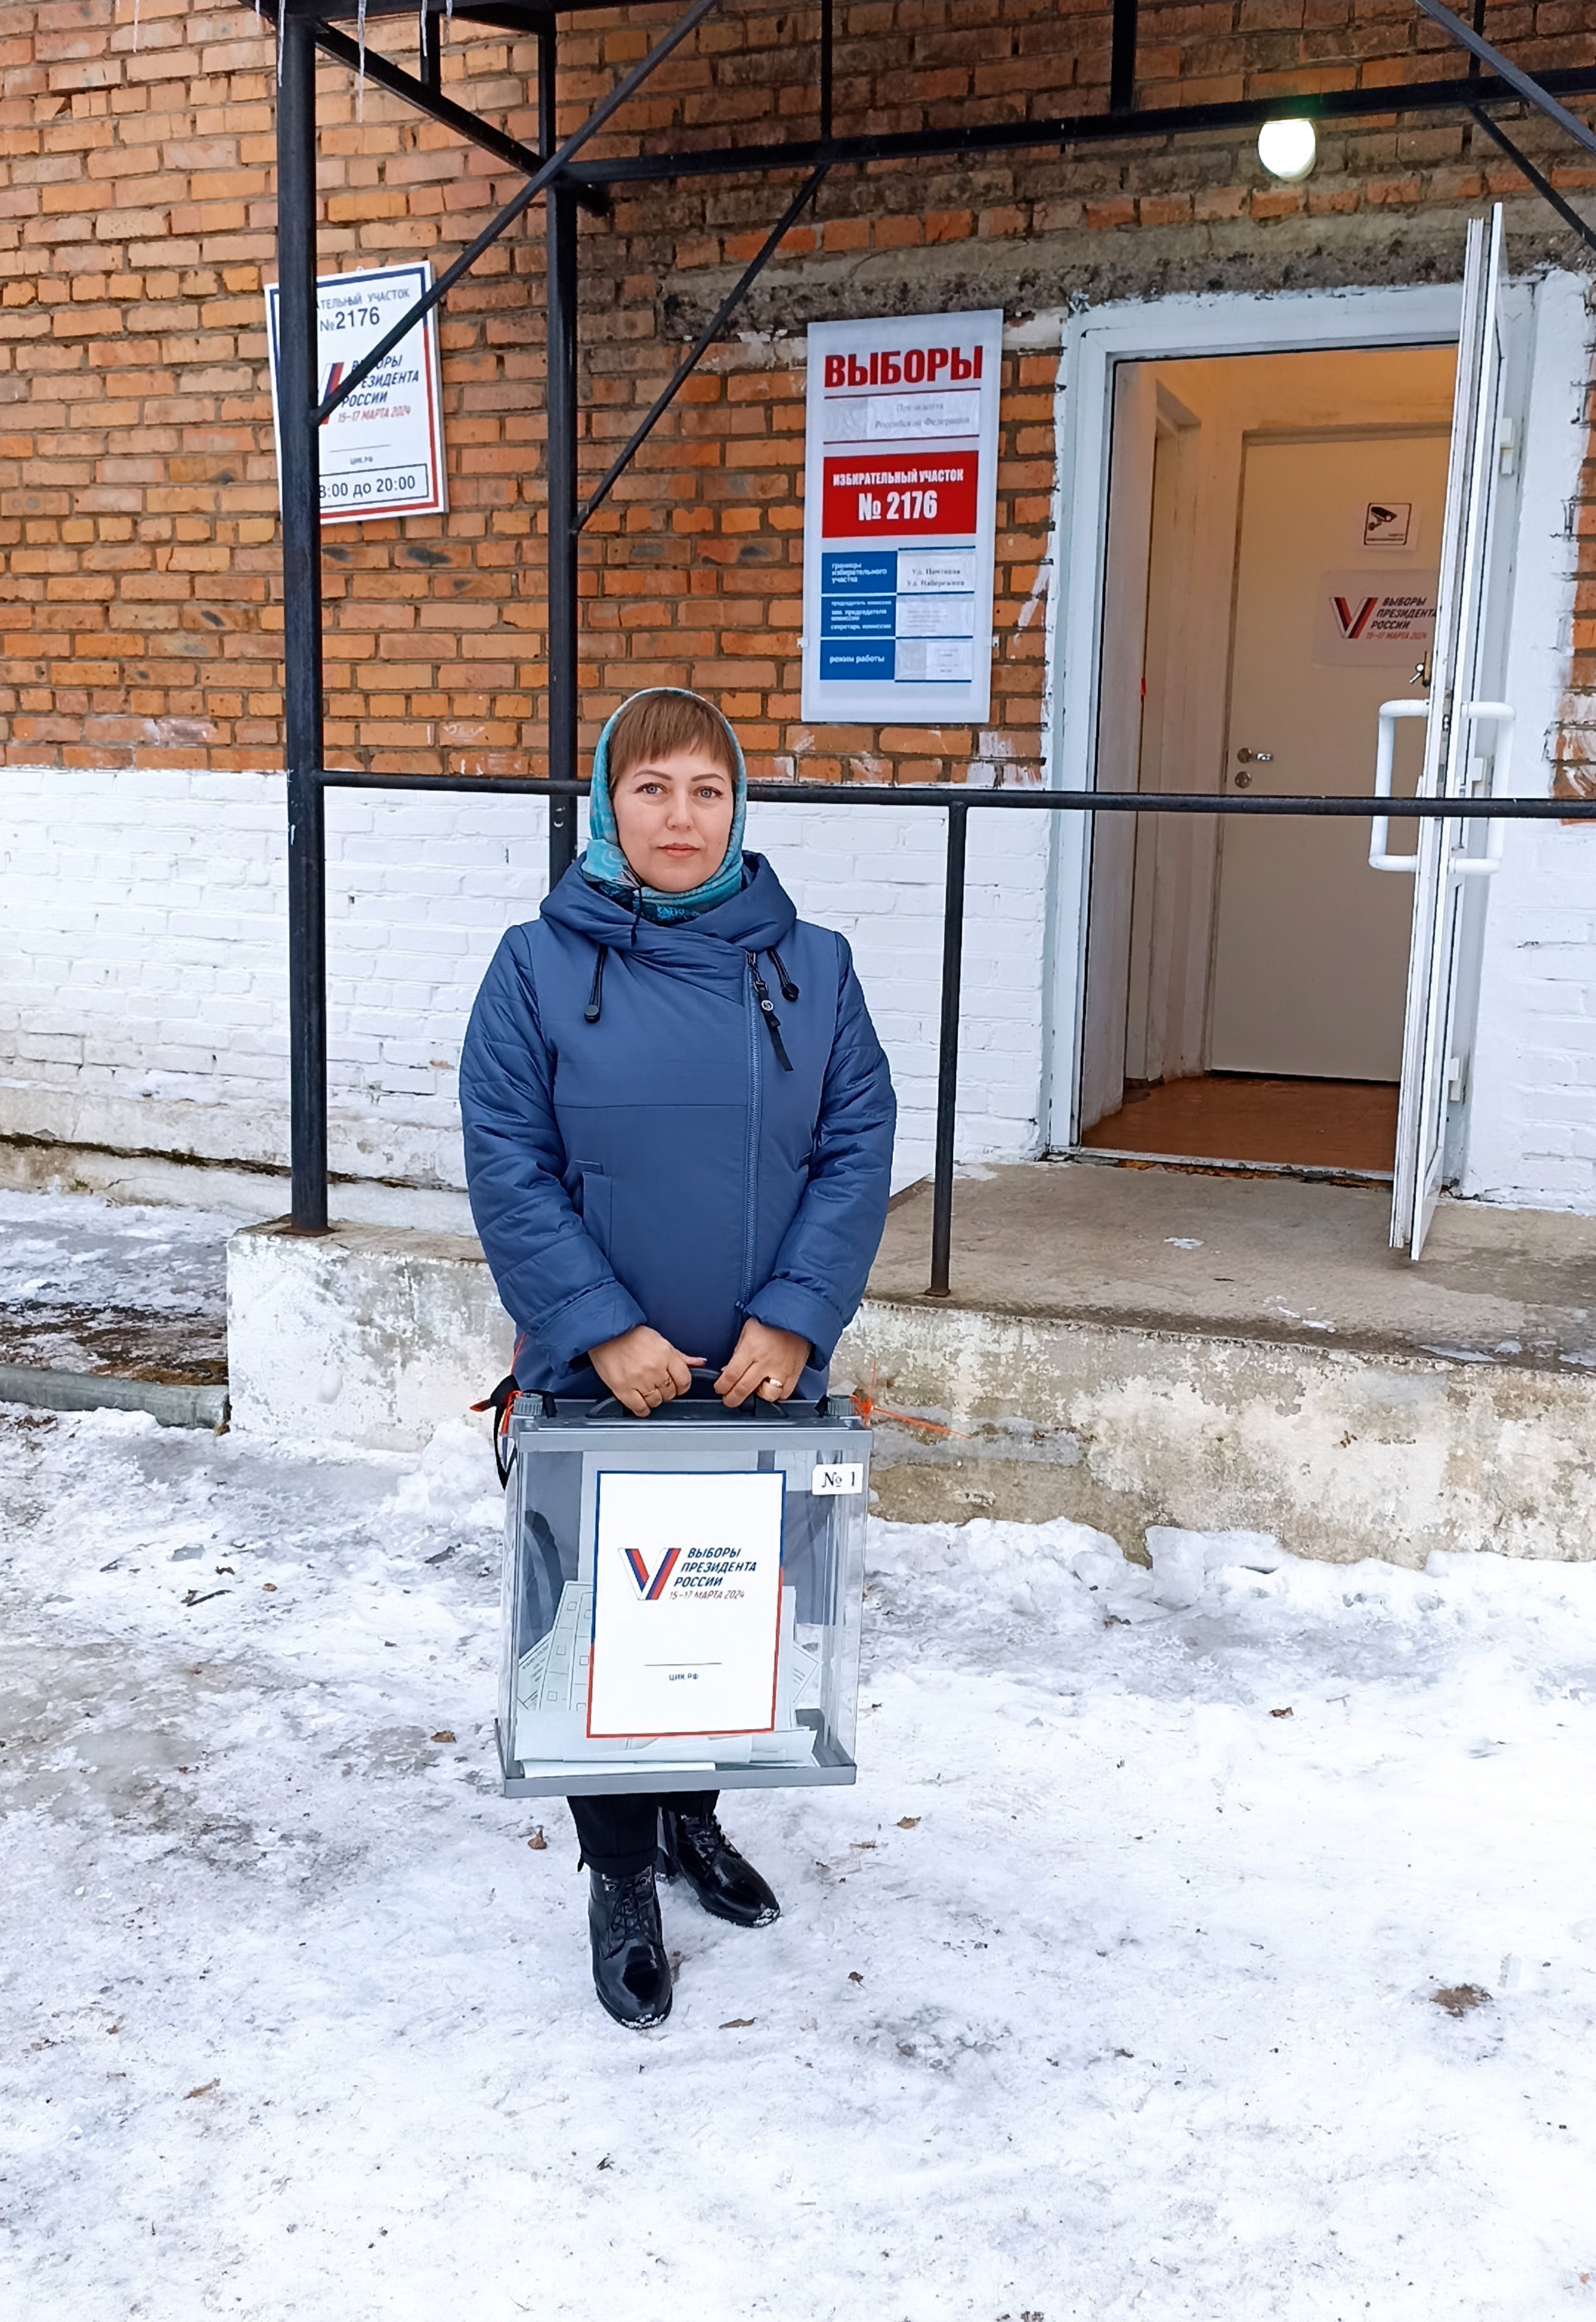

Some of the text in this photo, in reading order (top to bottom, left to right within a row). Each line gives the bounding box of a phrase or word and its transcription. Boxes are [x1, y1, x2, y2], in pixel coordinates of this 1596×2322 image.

[317, 288, 410, 310] ТЕЛЬНЫЙ УЧАСТОК
[352, 355, 403, 370] ВОРЫ
[824, 345, 983, 388] ВЫБОРЫ
[361, 370, 419, 388] ЕЗИДЕНТА
[341, 391, 388, 408] РОССИИ
[361, 407, 390, 420] МАРТА
[391, 405, 411, 417] 2024
[833, 468, 964, 487] ИЗБИРАТЕЛЬНЫЙ УЧАСТОК
[353, 483, 371, 498] до
[376, 475, 415, 493] 20:00
[858, 490, 938, 521] № 2176
[1382, 597, 1427, 607] ВЫБОРЫ
[1370, 620, 1411, 629] РОССИИ
[856, 654, 885, 664] работы
[851, 1471, 855, 1487] 1
[687, 1547, 742, 1558] ВЫБОРЫ
[681, 1562, 757, 1574] ПРЕЗИДЕНТА
[673, 1577, 724, 1587] РОССИИ
[694, 1590, 723, 1599] МАРТА
[724, 1589, 745, 1599] 2024
